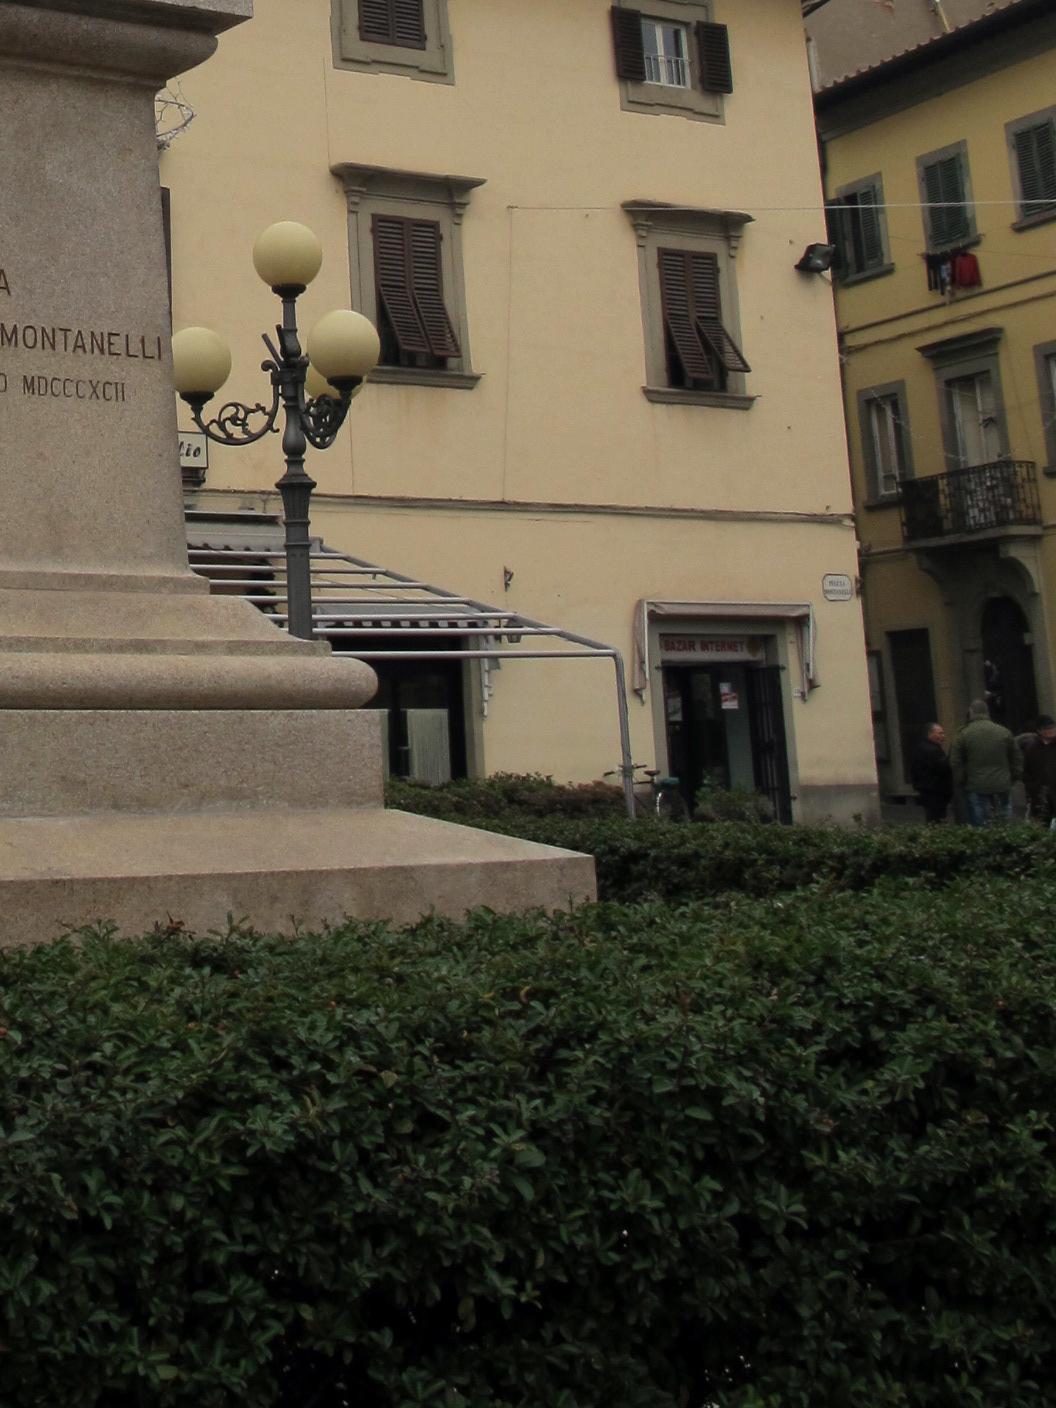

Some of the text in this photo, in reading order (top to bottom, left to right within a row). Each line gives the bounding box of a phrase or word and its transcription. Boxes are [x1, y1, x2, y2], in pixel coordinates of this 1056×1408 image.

[0, 323, 162, 361] MONTANELLI
[23, 375, 126, 402] MDCCCXCII
[664, 639, 745, 653] BAZAR INTERNET
